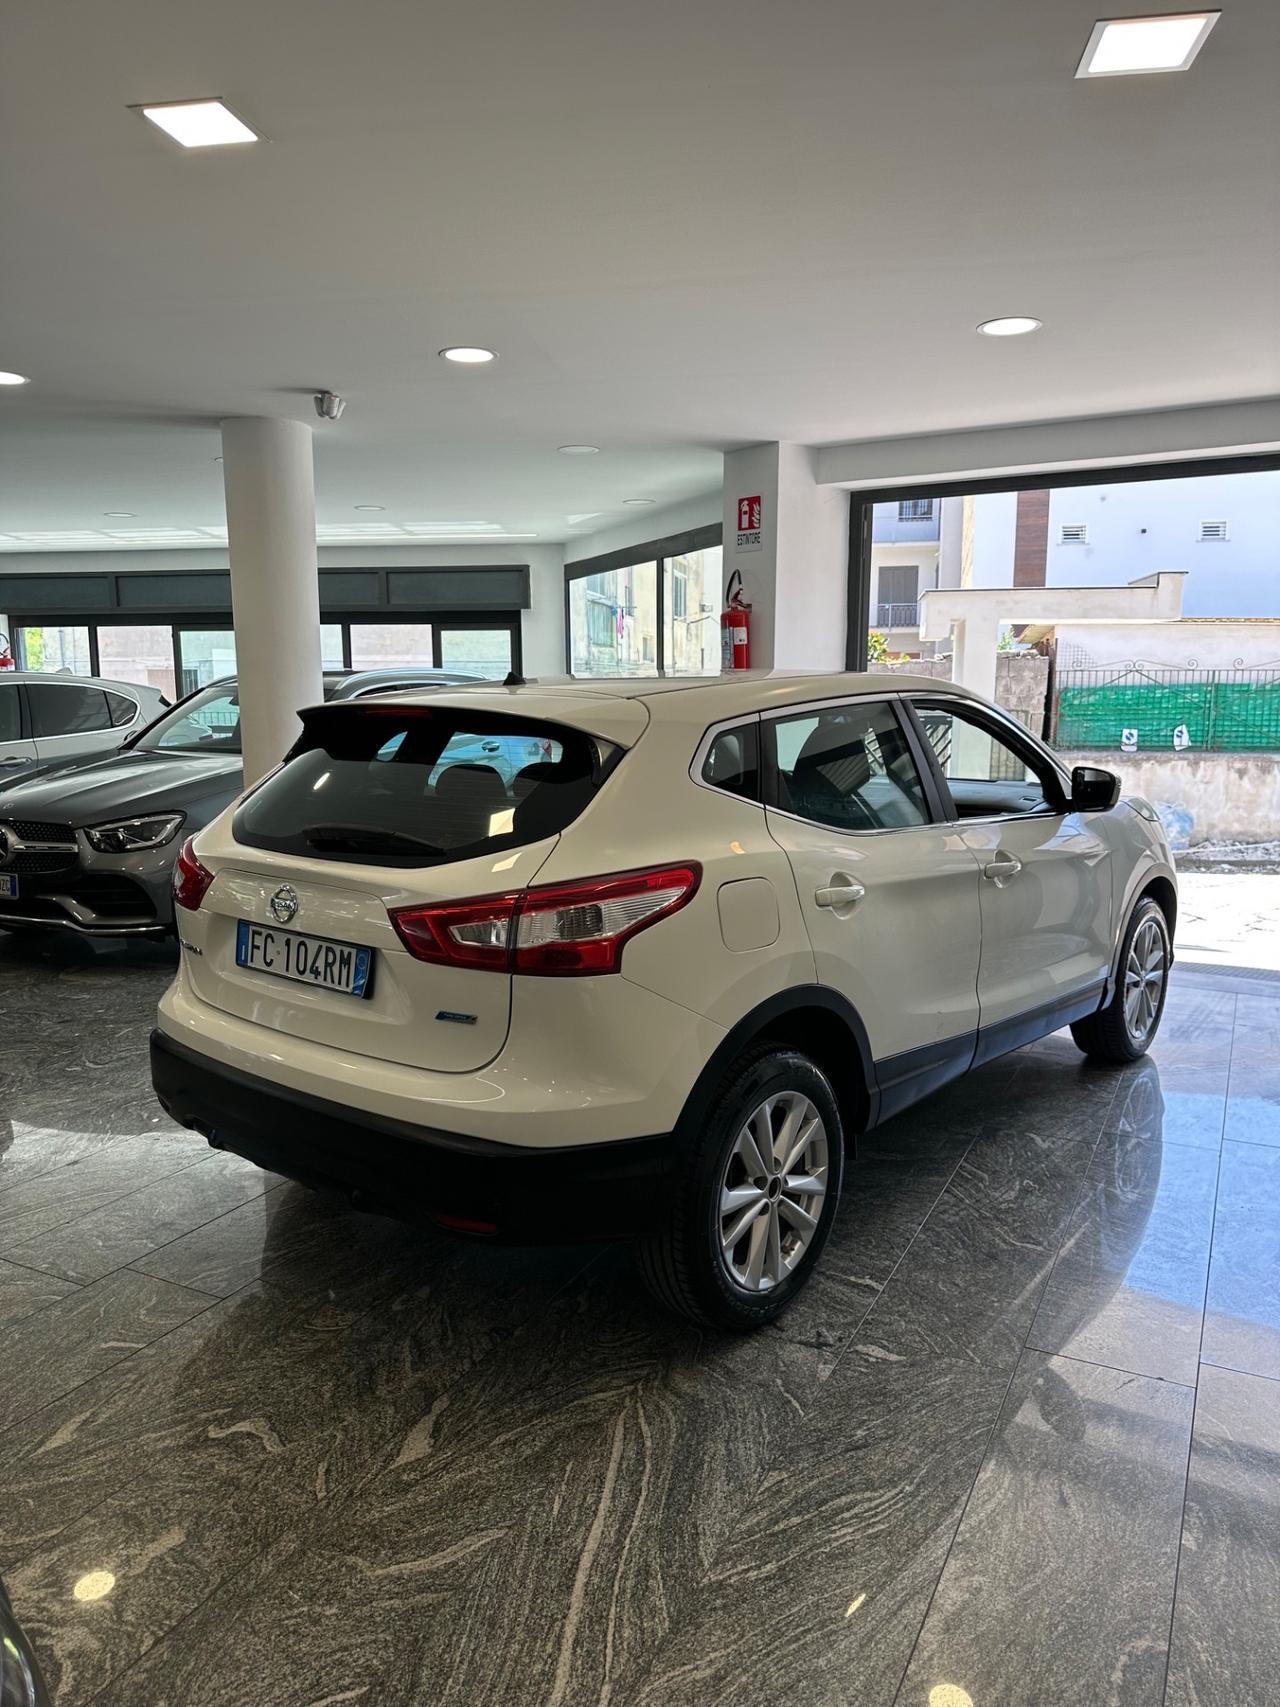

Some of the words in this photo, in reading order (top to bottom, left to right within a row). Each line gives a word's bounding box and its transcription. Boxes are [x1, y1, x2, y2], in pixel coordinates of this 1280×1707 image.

[737, 531, 761, 546] ESTINTORE
[250, 929, 276, 968] FC
[284, 937, 352, 989] 104RM
